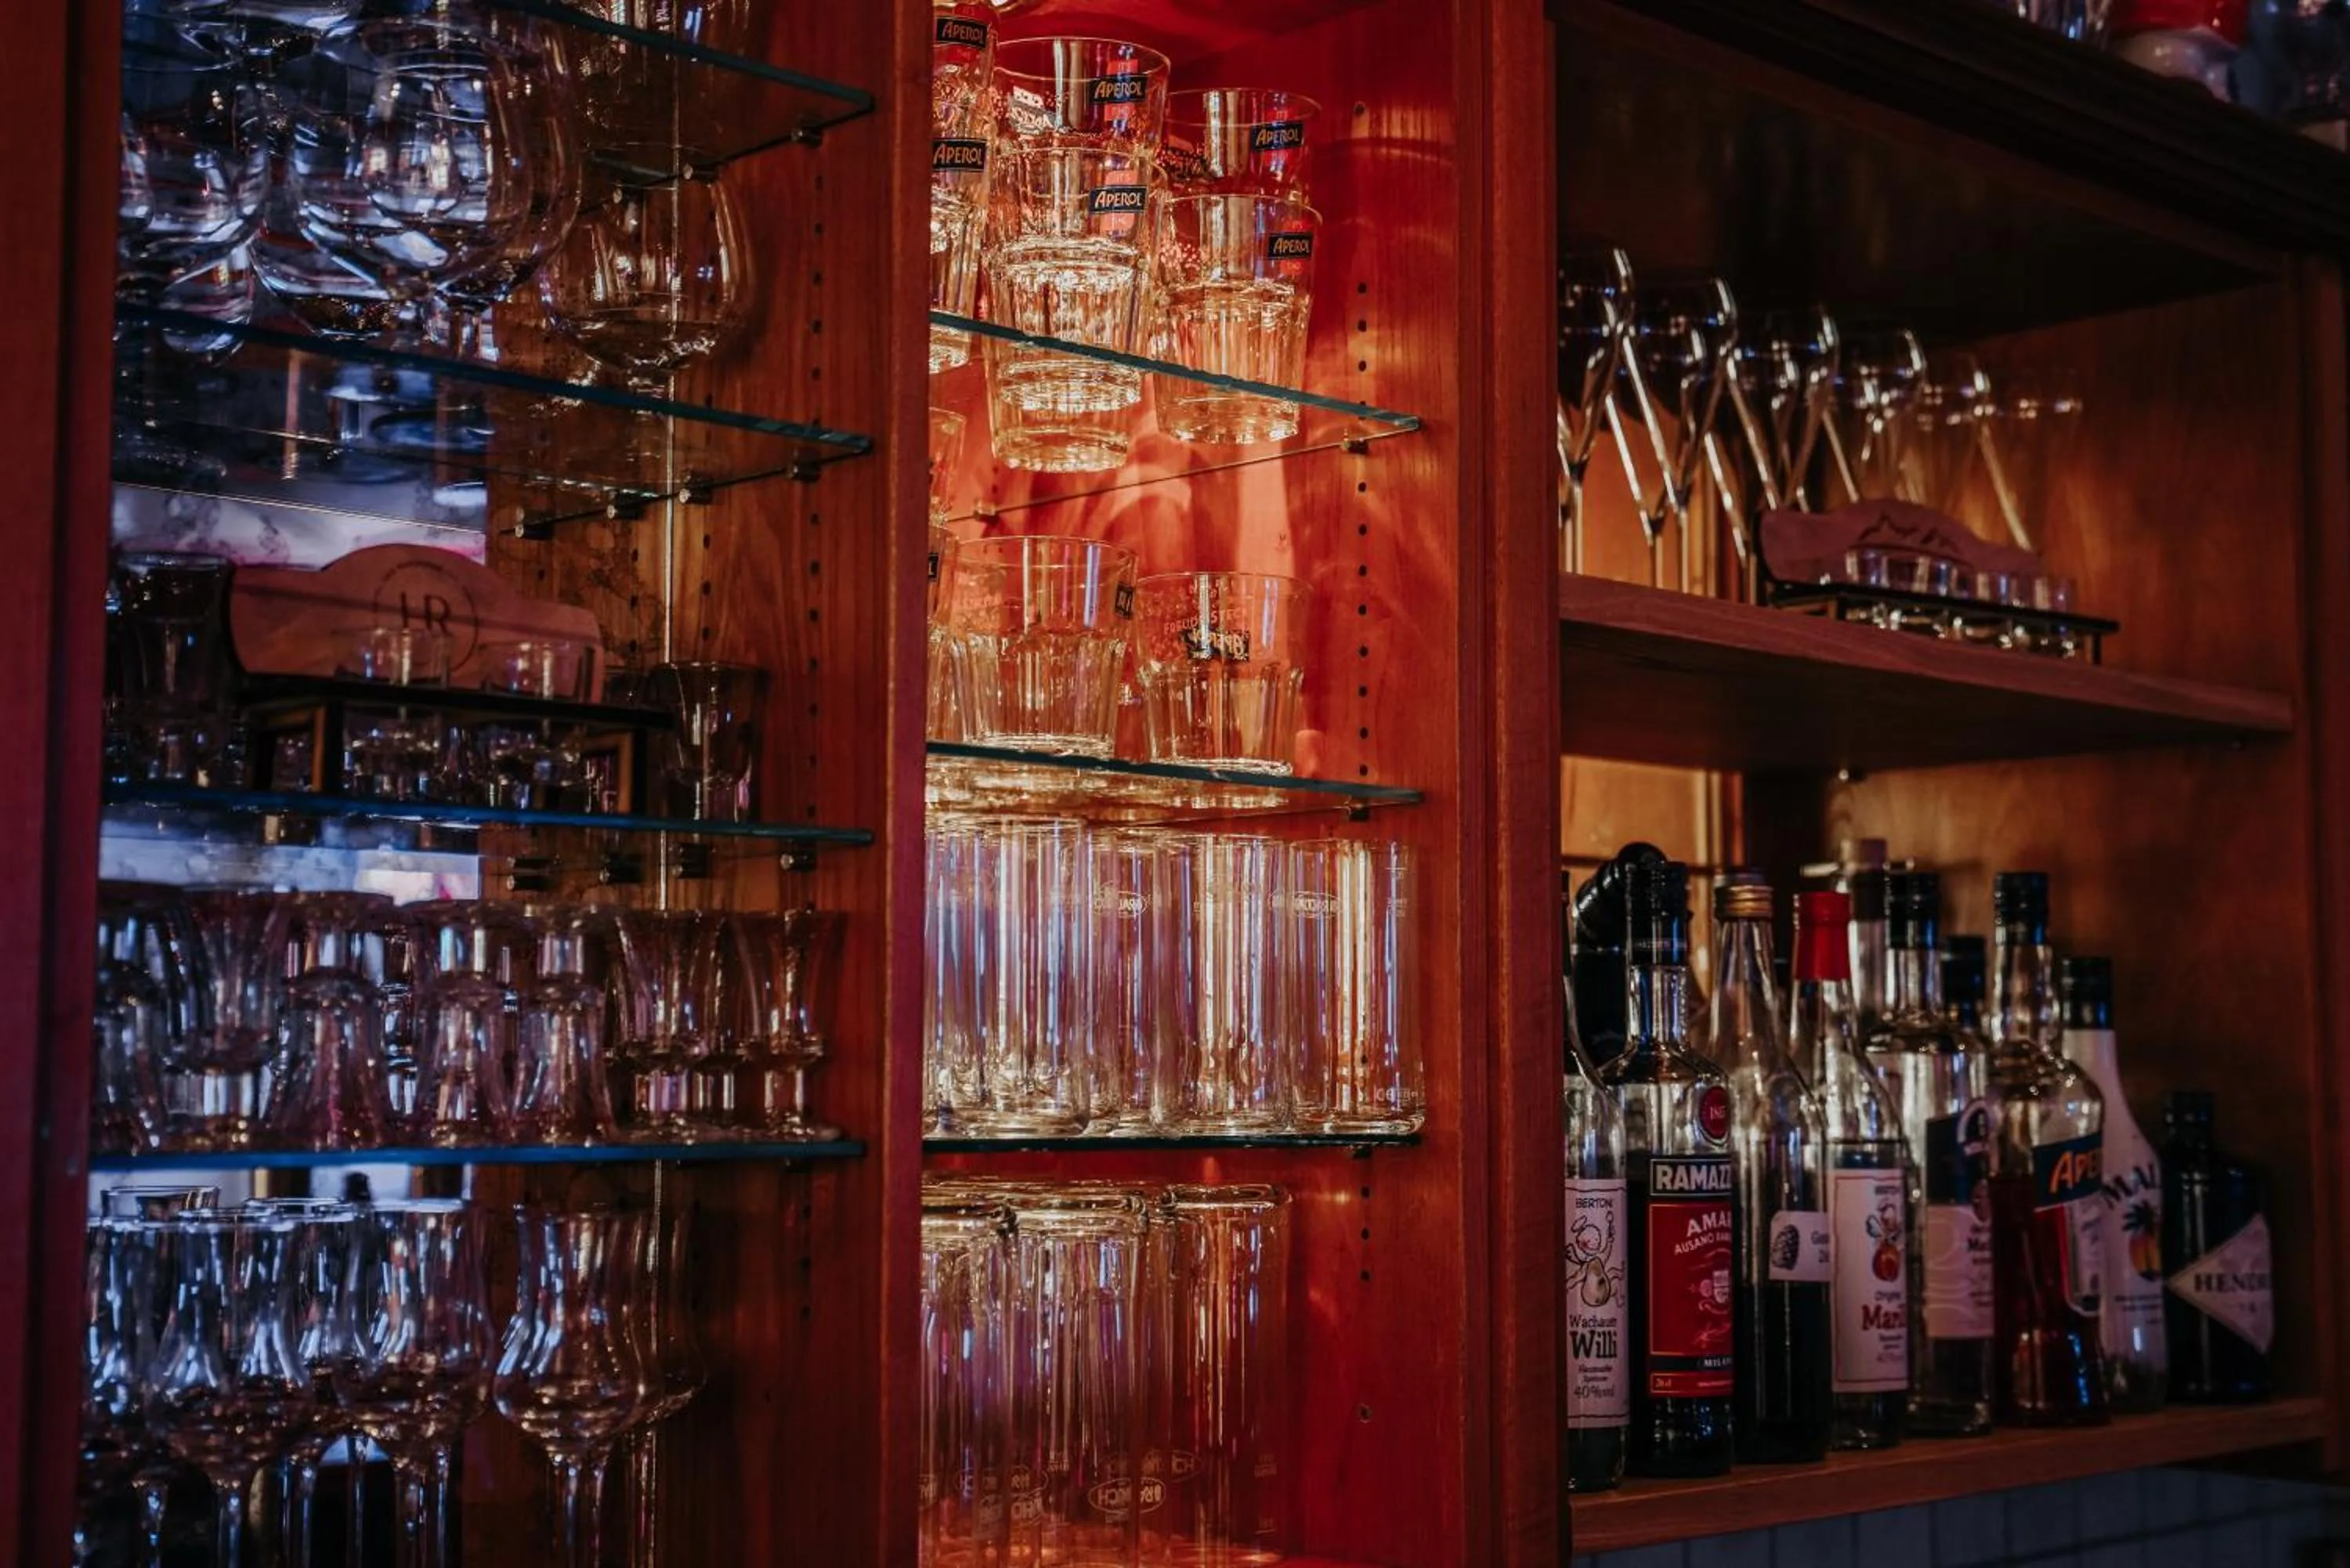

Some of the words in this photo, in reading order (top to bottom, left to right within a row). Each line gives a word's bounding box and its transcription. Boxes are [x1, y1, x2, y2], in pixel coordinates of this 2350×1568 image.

[942, 21, 985, 45] APEROL
[1094, 80, 1143, 99] APEROL
[1256, 128, 1300, 146] APEROL
[933, 142, 983, 165] APEROL
[1094, 190, 1142, 208] APEROL
[1273, 237, 1311, 255] APEROL
[1569, 1330, 1618, 1360] Willi
